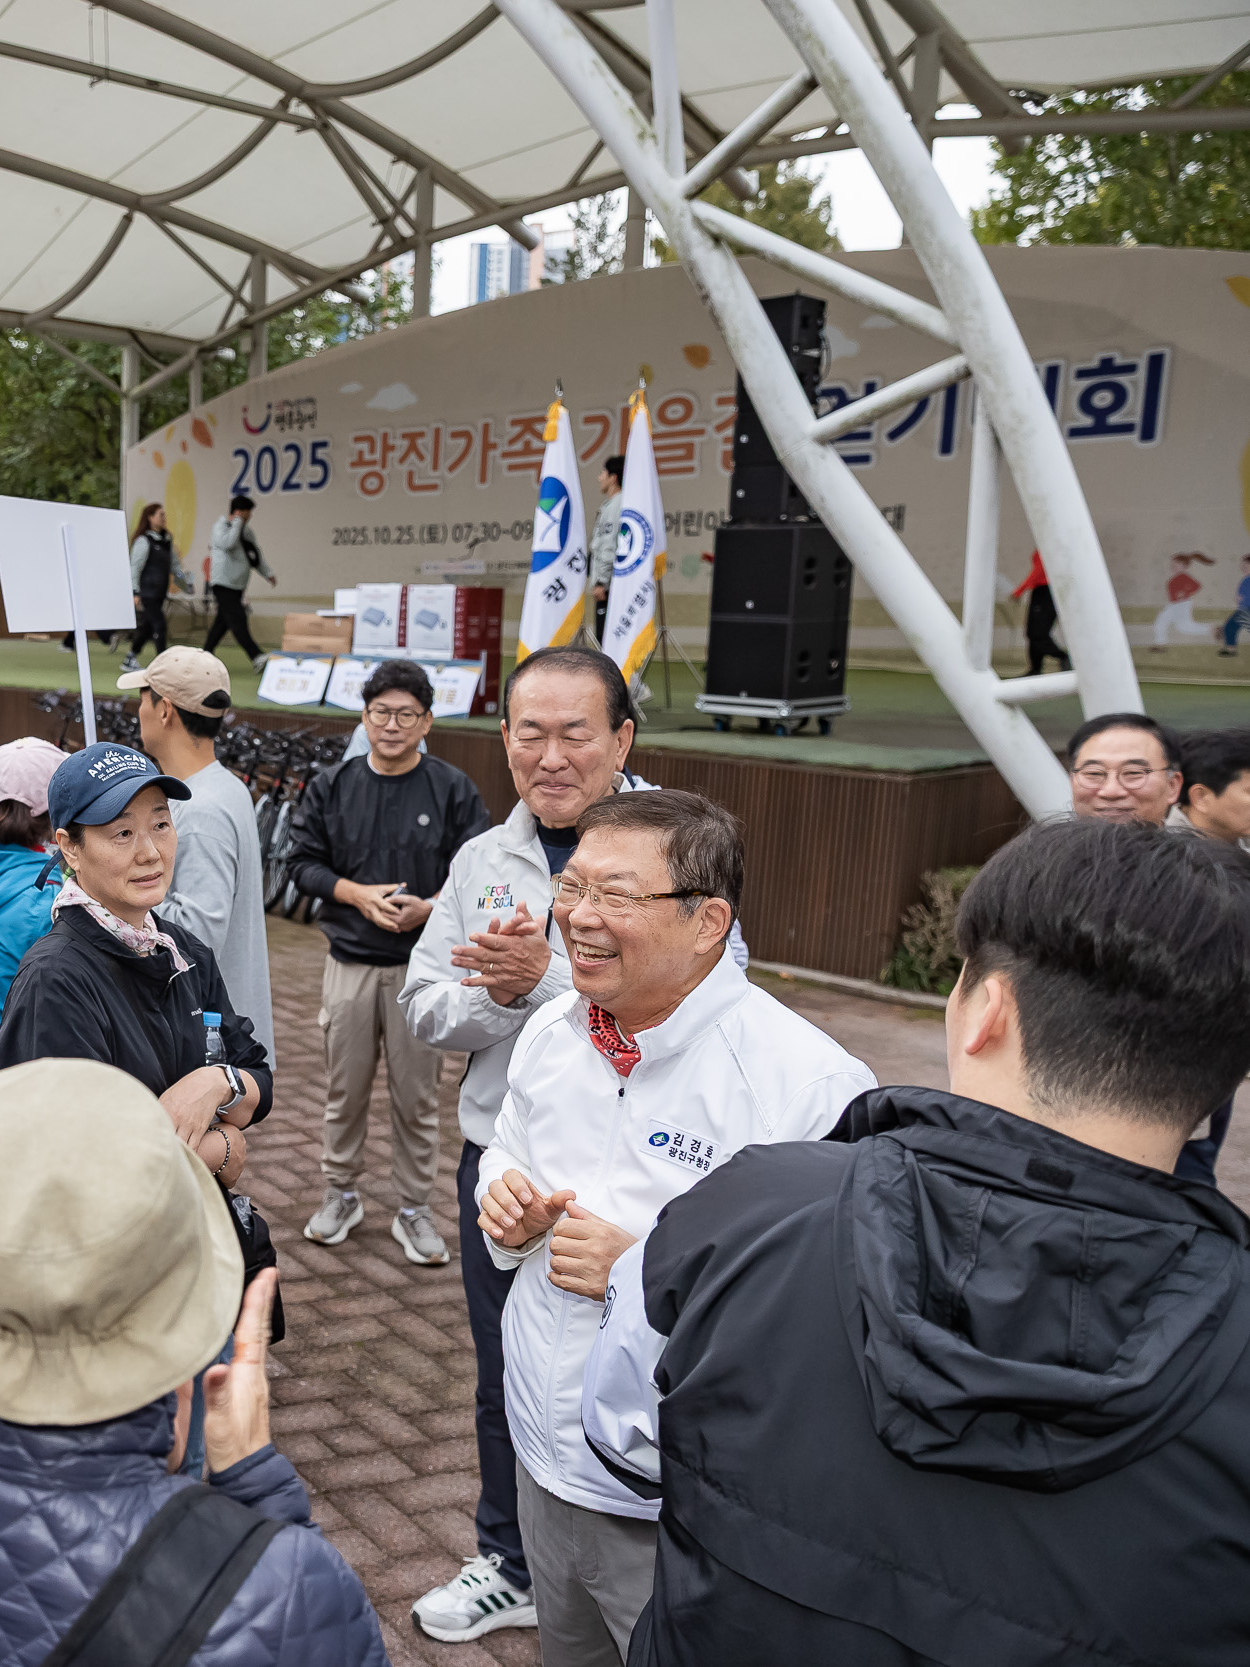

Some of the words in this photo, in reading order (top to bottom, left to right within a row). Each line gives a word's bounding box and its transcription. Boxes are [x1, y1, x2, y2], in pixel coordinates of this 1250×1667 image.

[232, 441, 330, 494] 2025
[350, 416, 547, 495] 광진가족
[88, 754, 147, 778] AMERICAN
[668, 1146, 711, 1171] 광진구청장
